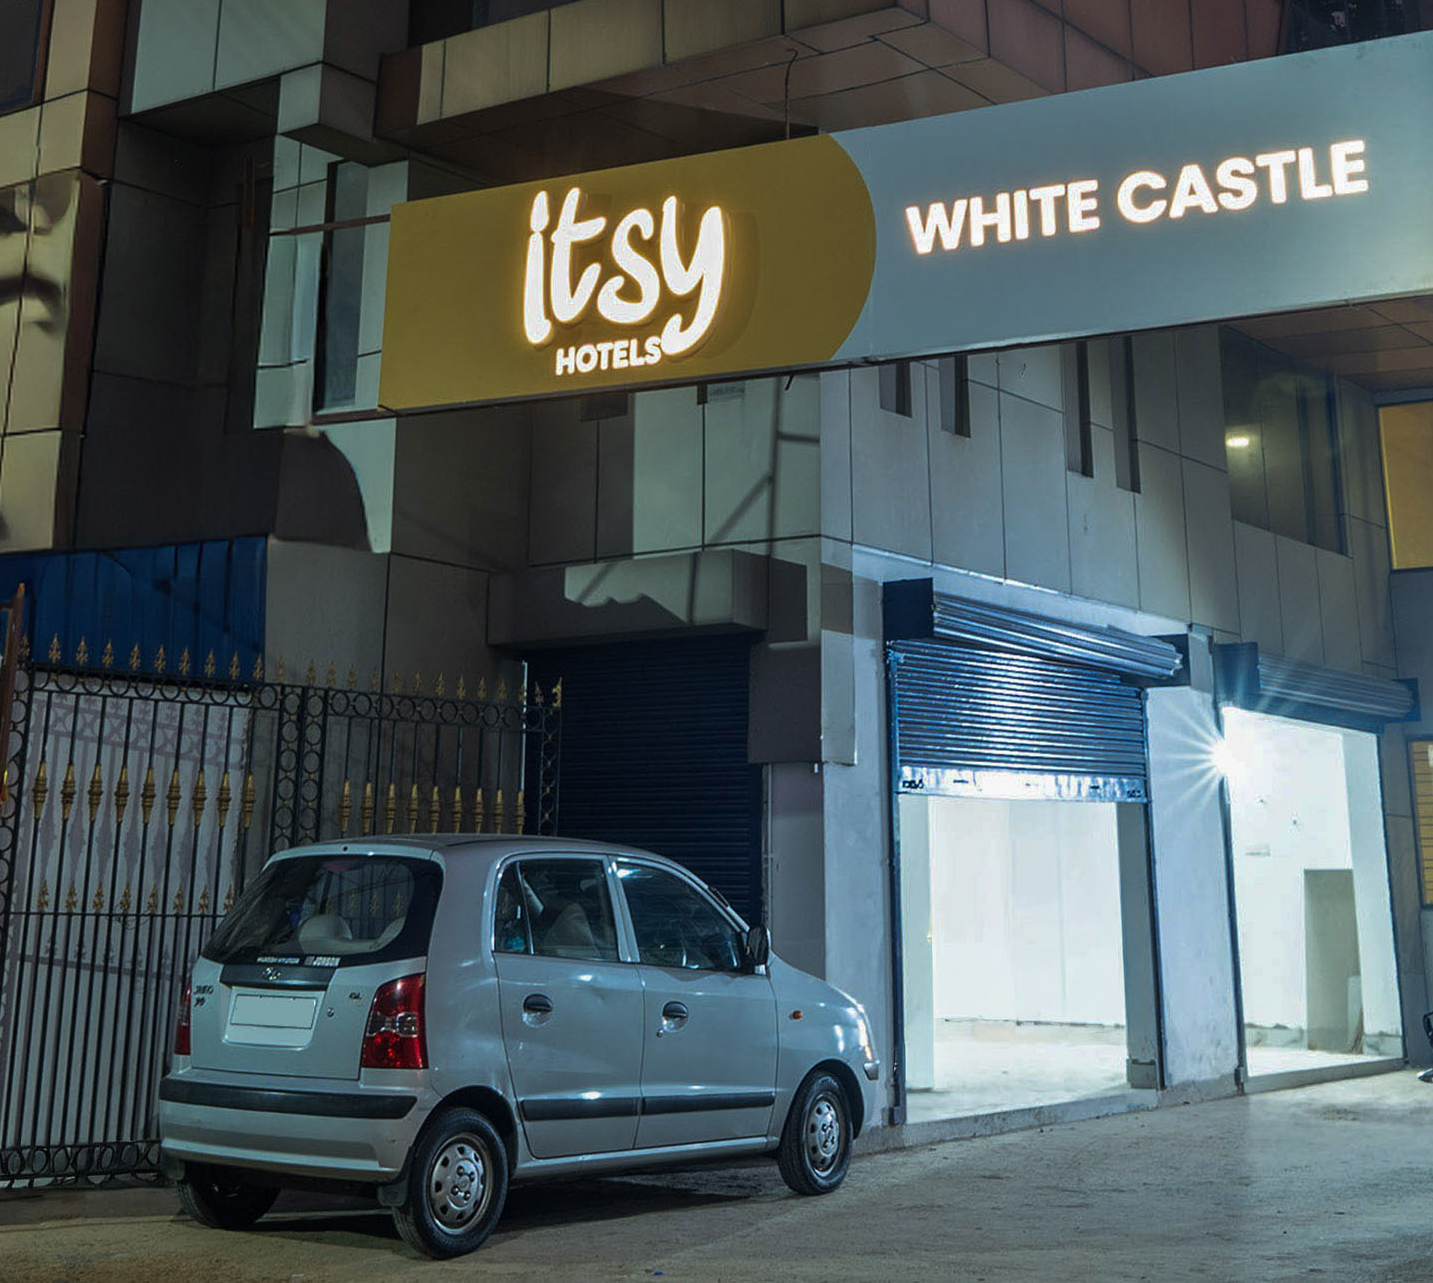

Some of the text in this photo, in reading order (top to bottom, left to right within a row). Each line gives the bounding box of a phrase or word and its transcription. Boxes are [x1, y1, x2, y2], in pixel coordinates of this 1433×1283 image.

[905, 139, 1368, 254] WHITE CASTLE
[524, 187, 724, 354] itsy
[555, 336, 662, 376] HOTELS
